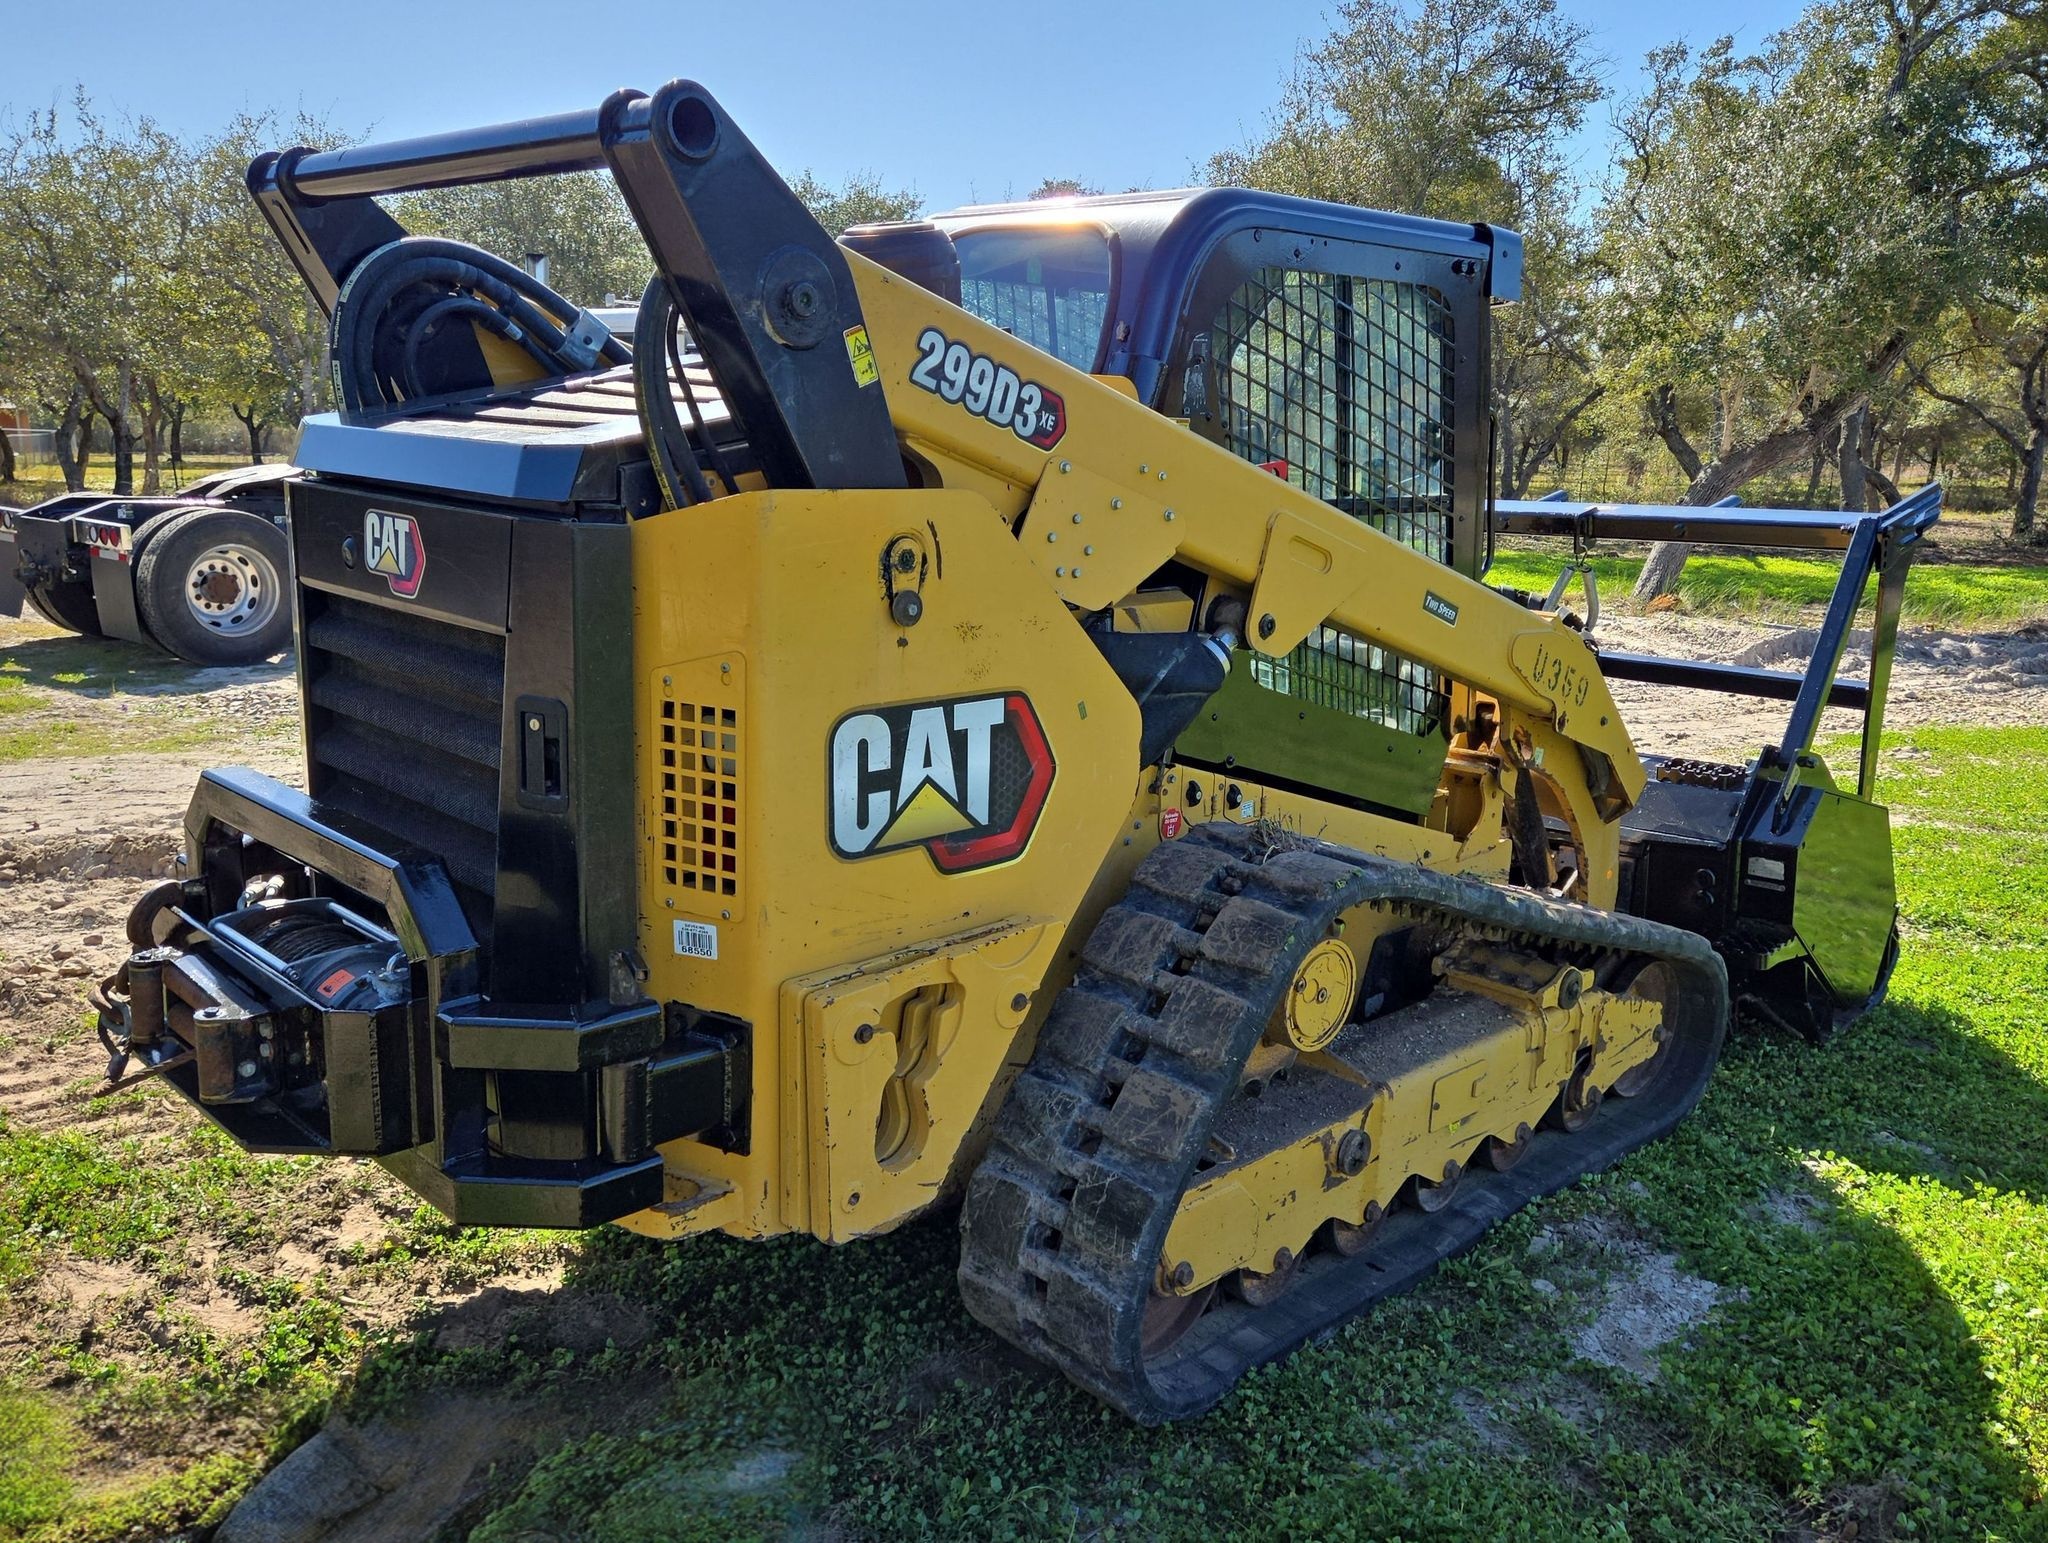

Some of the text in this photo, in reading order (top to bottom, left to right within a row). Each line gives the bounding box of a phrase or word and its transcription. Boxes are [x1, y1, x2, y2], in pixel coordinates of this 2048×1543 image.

[911, 330, 1056, 438] 299D3 XE
[366, 511, 410, 577] CAT
[833, 697, 1005, 853] CAT
[681, 945, 712, 957] 68550
